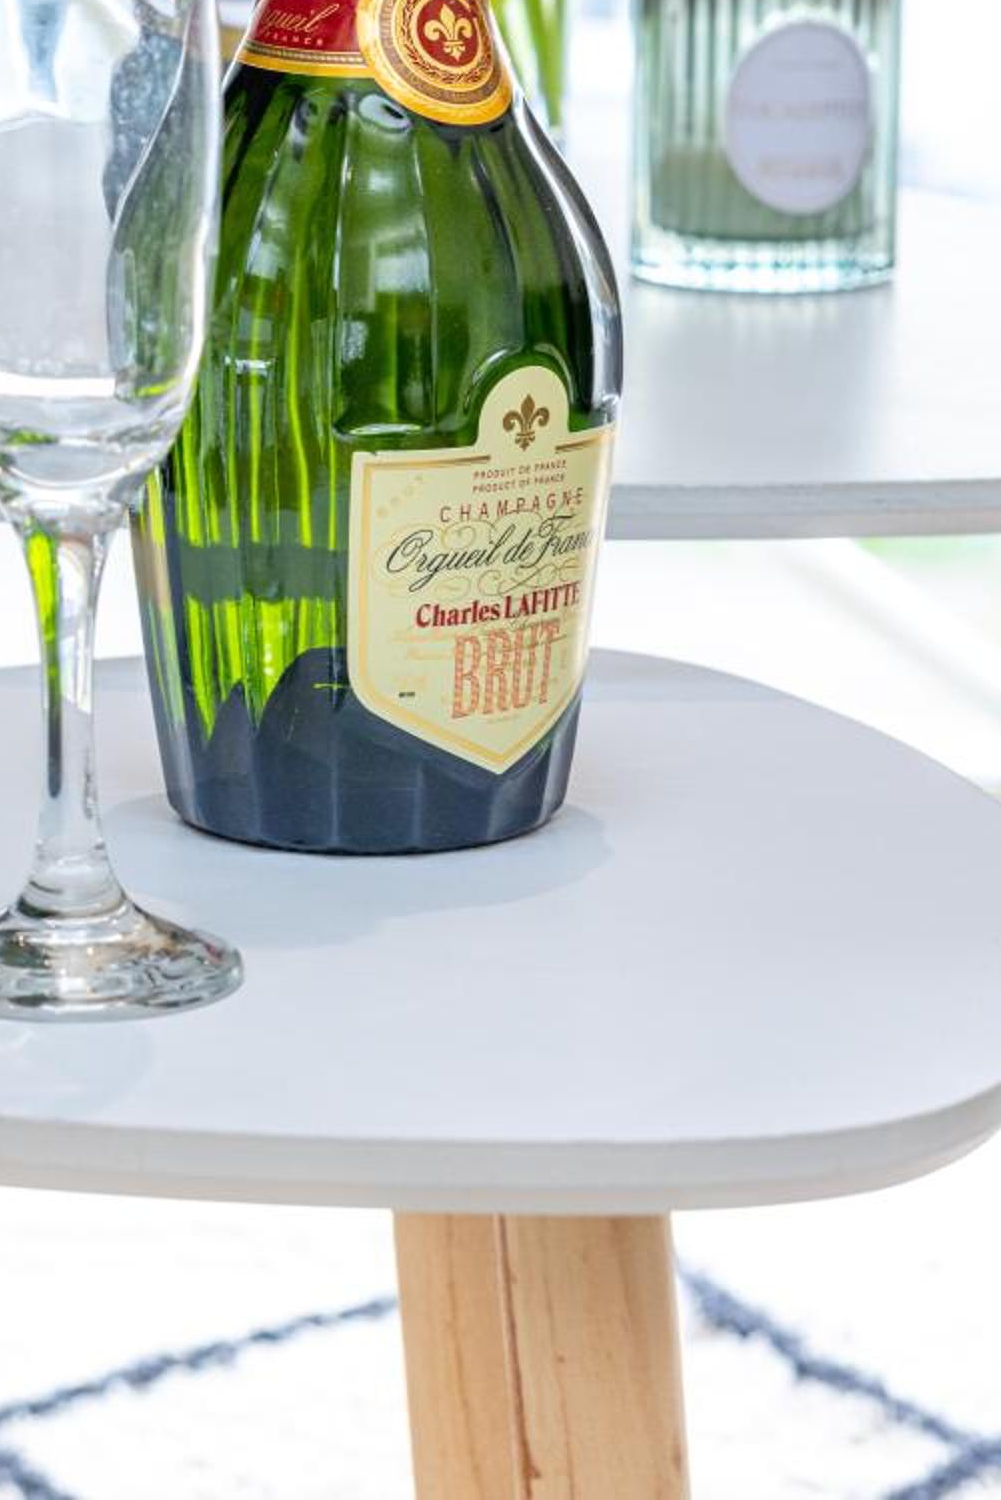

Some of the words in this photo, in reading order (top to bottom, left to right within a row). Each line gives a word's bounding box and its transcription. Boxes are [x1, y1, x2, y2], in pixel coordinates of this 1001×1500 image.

[471, 480, 516, 493] PRODUCT
[534, 473, 565, 485] FRANCE
[472, 467, 516, 479] PRODUIT
[534, 459, 567, 472] FRANCE
[439, 486, 584, 523] CHAMPAGNE
[385, 522, 516, 593] Orgueil
[503, 526, 533, 565] de
[415, 600, 501, 628] Charles
[503, 581, 581, 619] LAFITTE
[451, 619, 561, 719] BRUT
